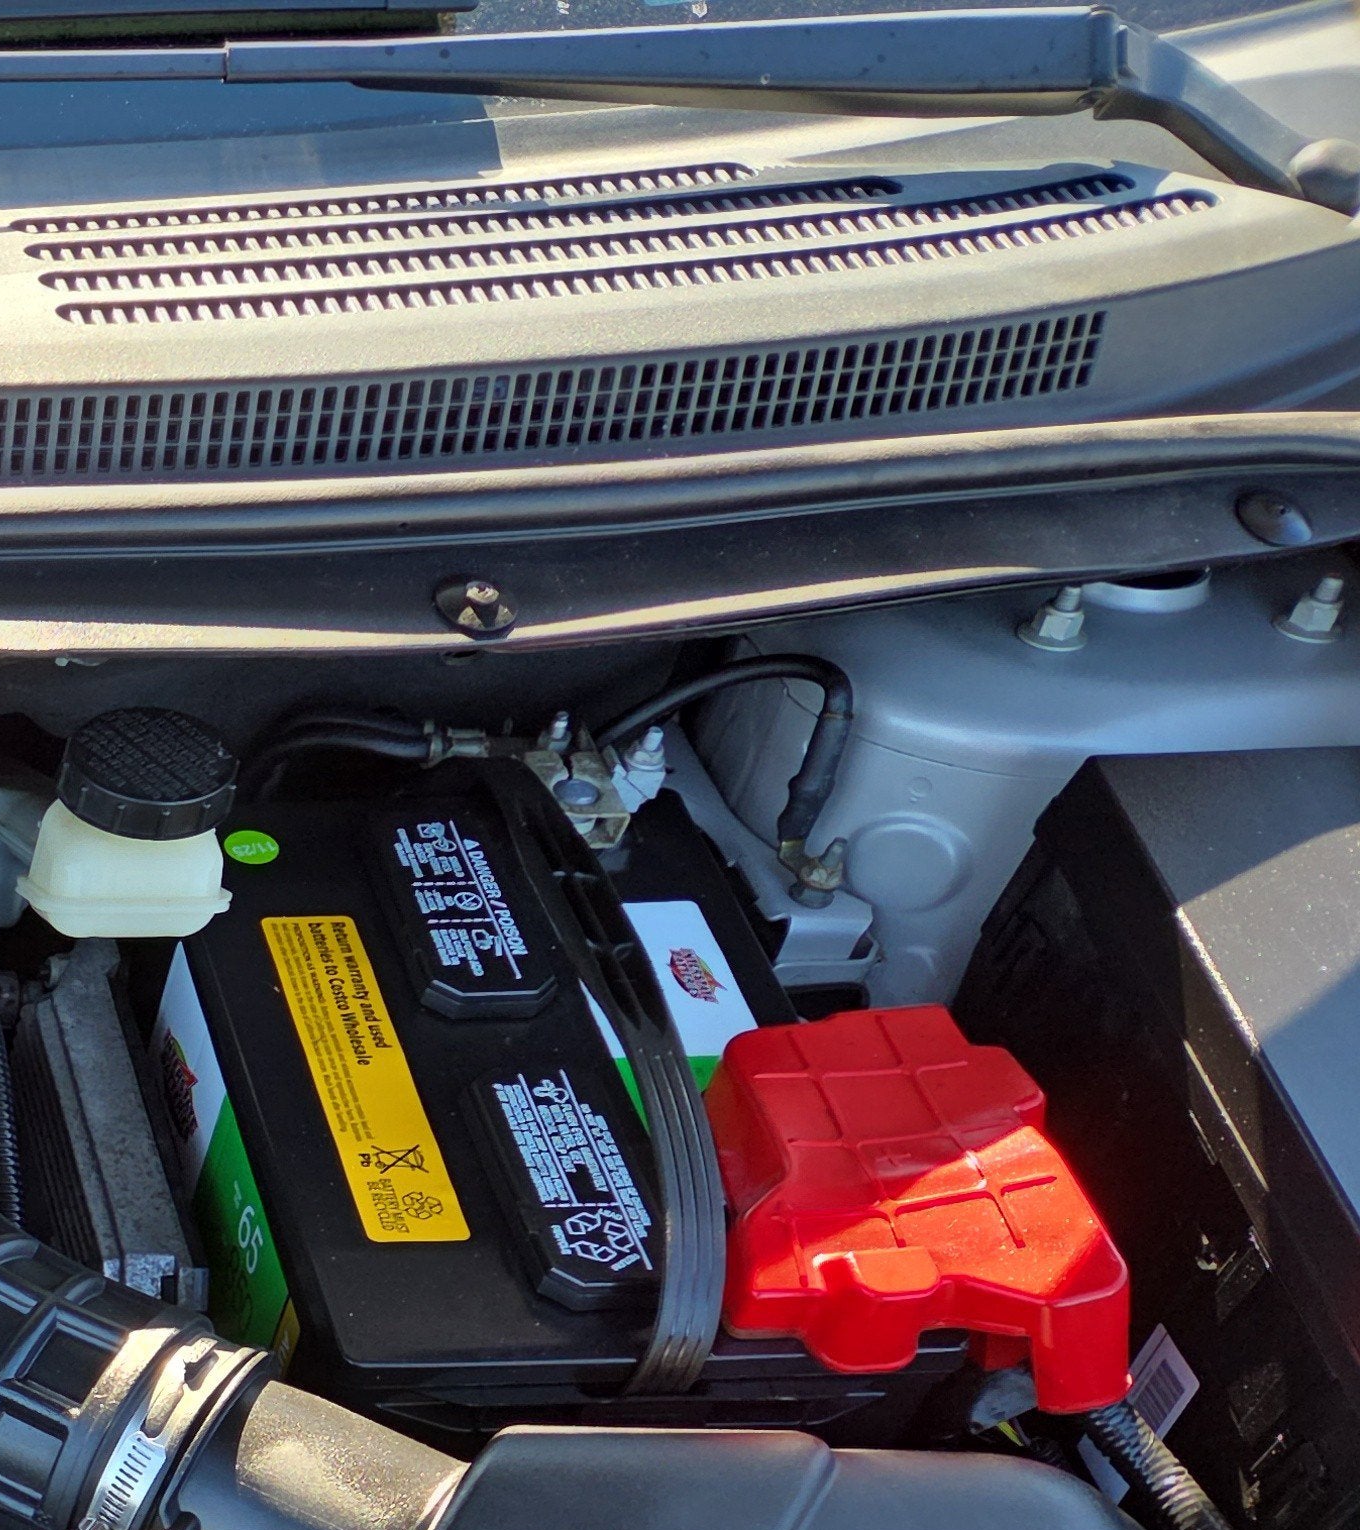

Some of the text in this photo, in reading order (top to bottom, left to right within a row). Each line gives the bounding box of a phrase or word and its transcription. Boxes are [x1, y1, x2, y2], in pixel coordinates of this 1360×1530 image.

[468, 850, 502, 898] DANGER
[494, 909, 529, 955] POISON
[307, 921, 372, 1065] batteries to Costco Wholesale
[330, 921, 390, 1048] Return warranty and used
[357, 1152, 372, 1167] Pb
[238, 1205, 264, 1275] 65
